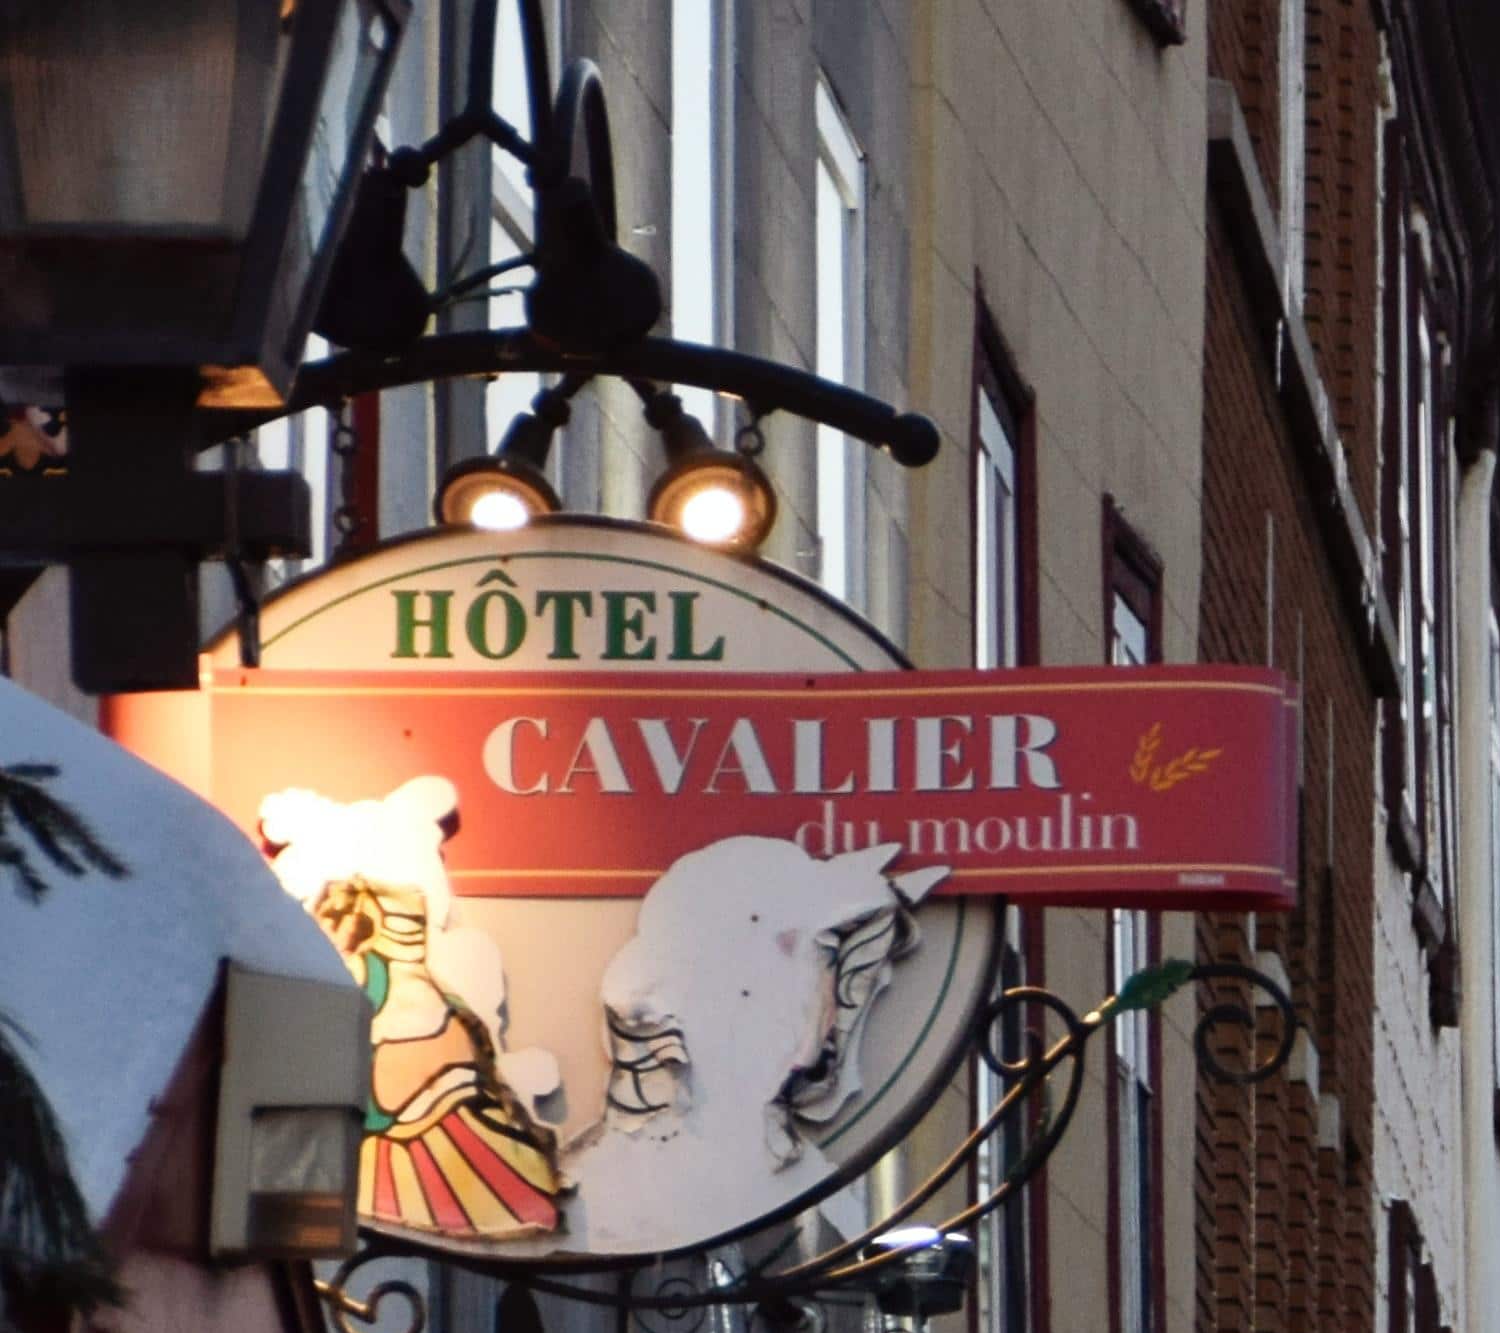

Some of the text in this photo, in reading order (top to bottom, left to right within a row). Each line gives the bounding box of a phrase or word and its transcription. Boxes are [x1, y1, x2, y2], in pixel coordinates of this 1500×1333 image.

[390, 569, 725, 661] HÔTEL
[481, 713, 1061, 796] CAVALIER
[794, 793, 1139, 857] du moulin
